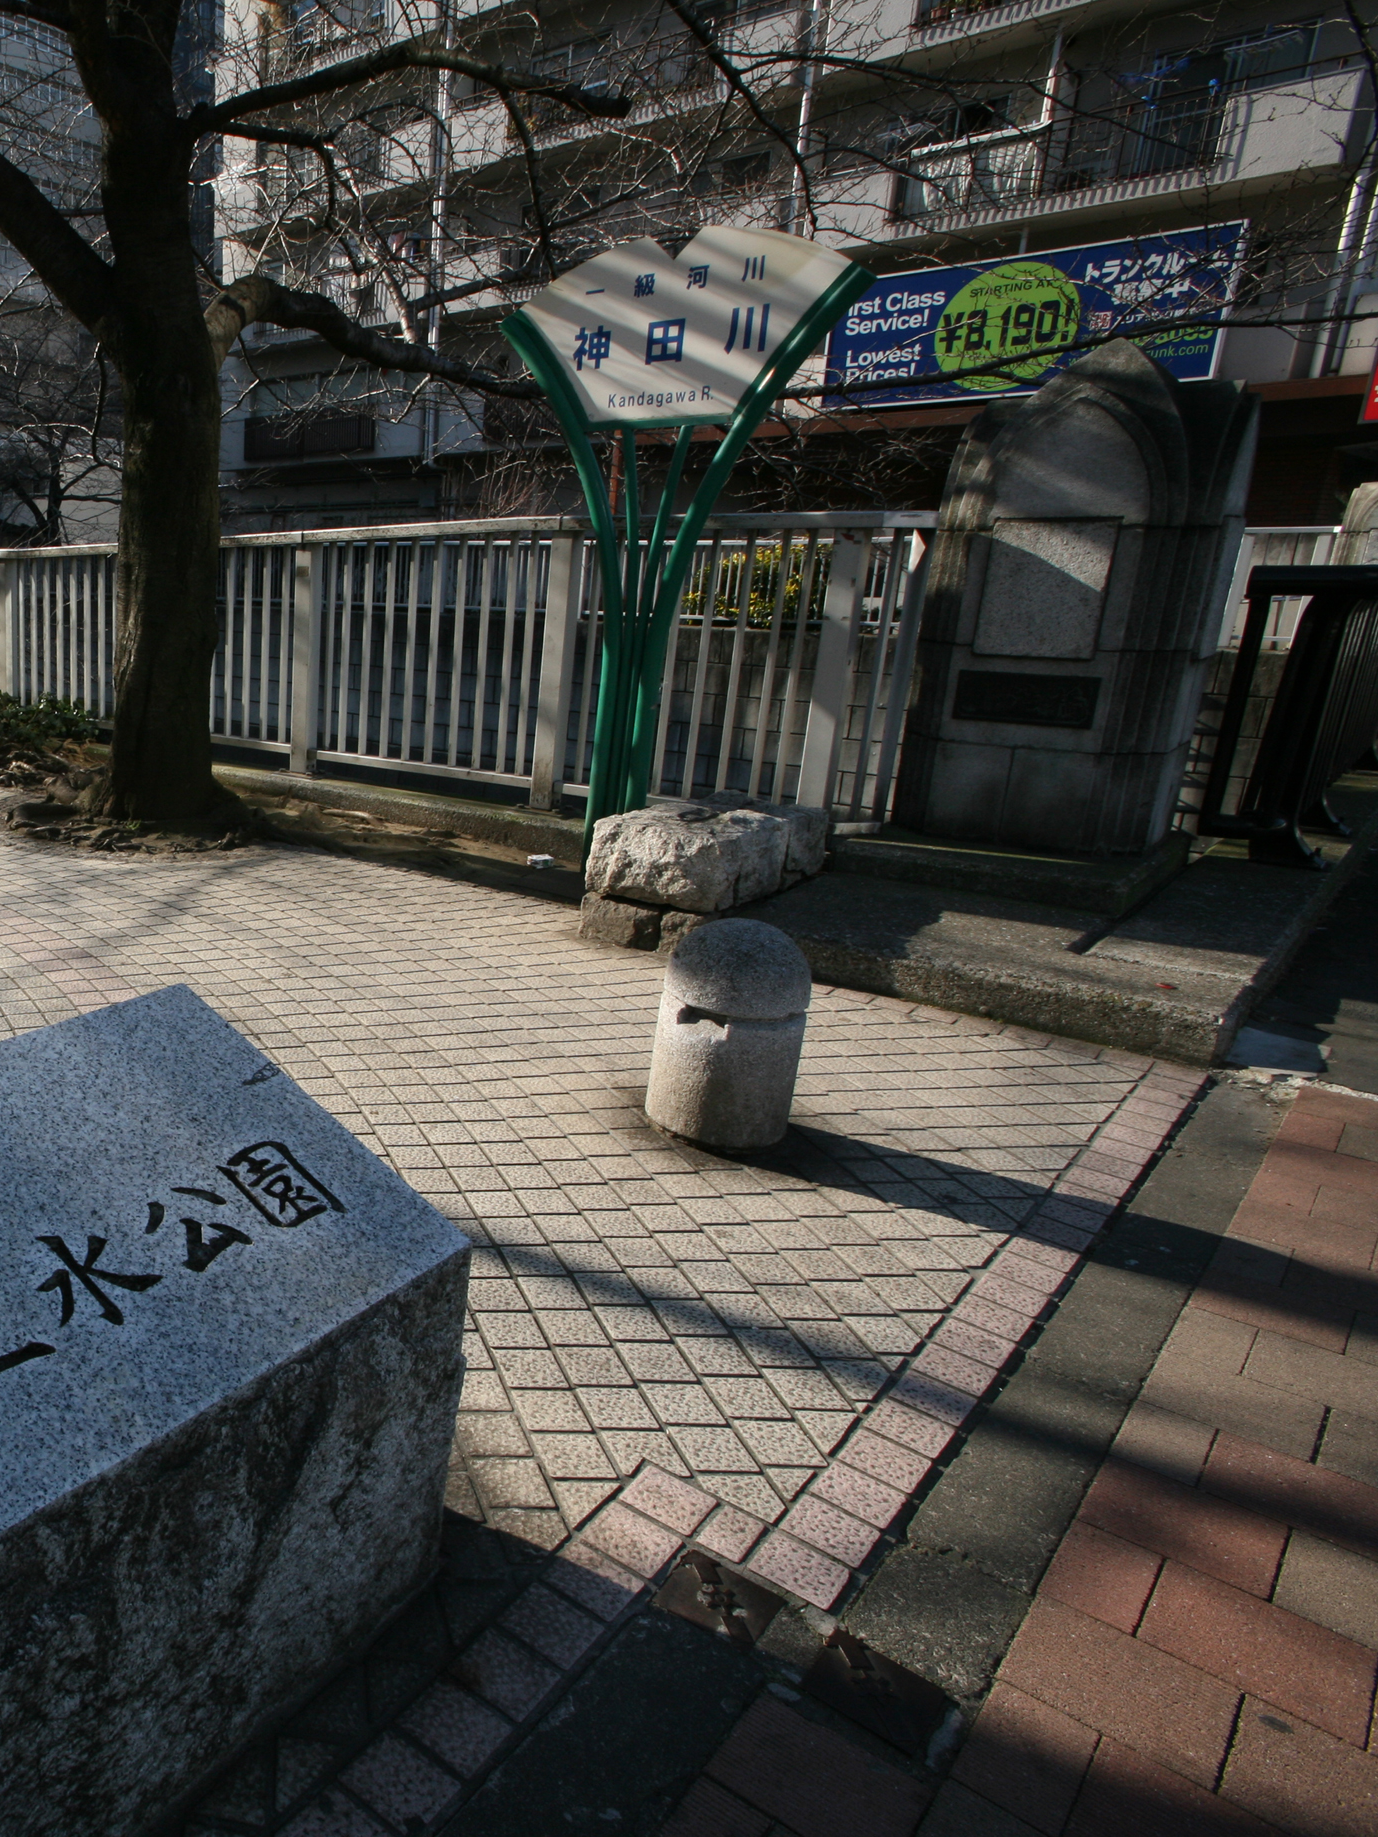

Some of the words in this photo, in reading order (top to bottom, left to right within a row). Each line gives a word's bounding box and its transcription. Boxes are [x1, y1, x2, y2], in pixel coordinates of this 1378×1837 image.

[585, 254, 765, 298] 一級河川
[885, 290, 946, 312] Class
[969, 281, 1033, 298] STARTING
[844, 308, 930, 336] Service!
[572, 303, 771, 371] 神田川
[845, 343, 922, 368] Lowest
[608, 390, 696, 408] Kandagawa
[701, 385, 714, 401] R.
